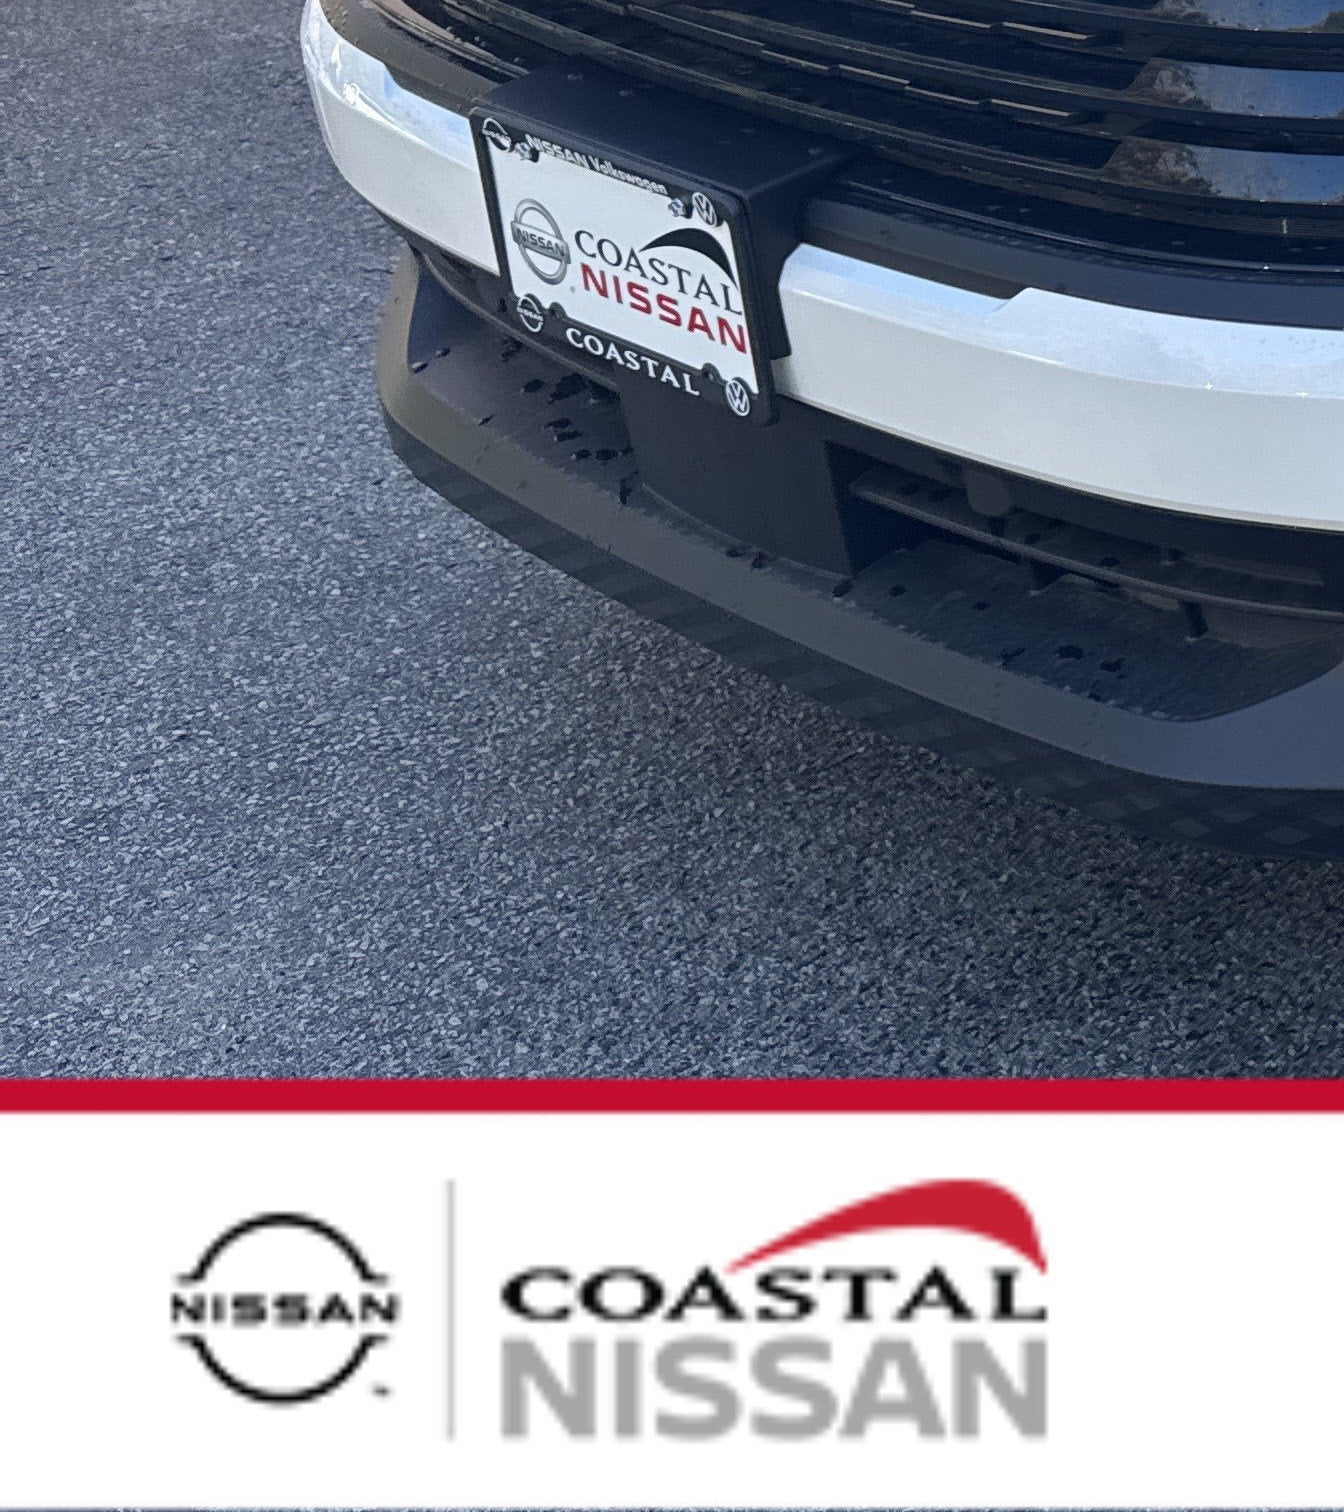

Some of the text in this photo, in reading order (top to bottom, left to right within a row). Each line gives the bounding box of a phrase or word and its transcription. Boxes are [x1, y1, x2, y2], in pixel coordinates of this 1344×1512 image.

[525, 133, 591, 170] NISSAN
[515, 227, 567, 258] NISSAN
[574, 229, 743, 316] COASTAL
[580, 263, 748, 355] NISSAN
[565, 327, 701, 397] COASTAL
